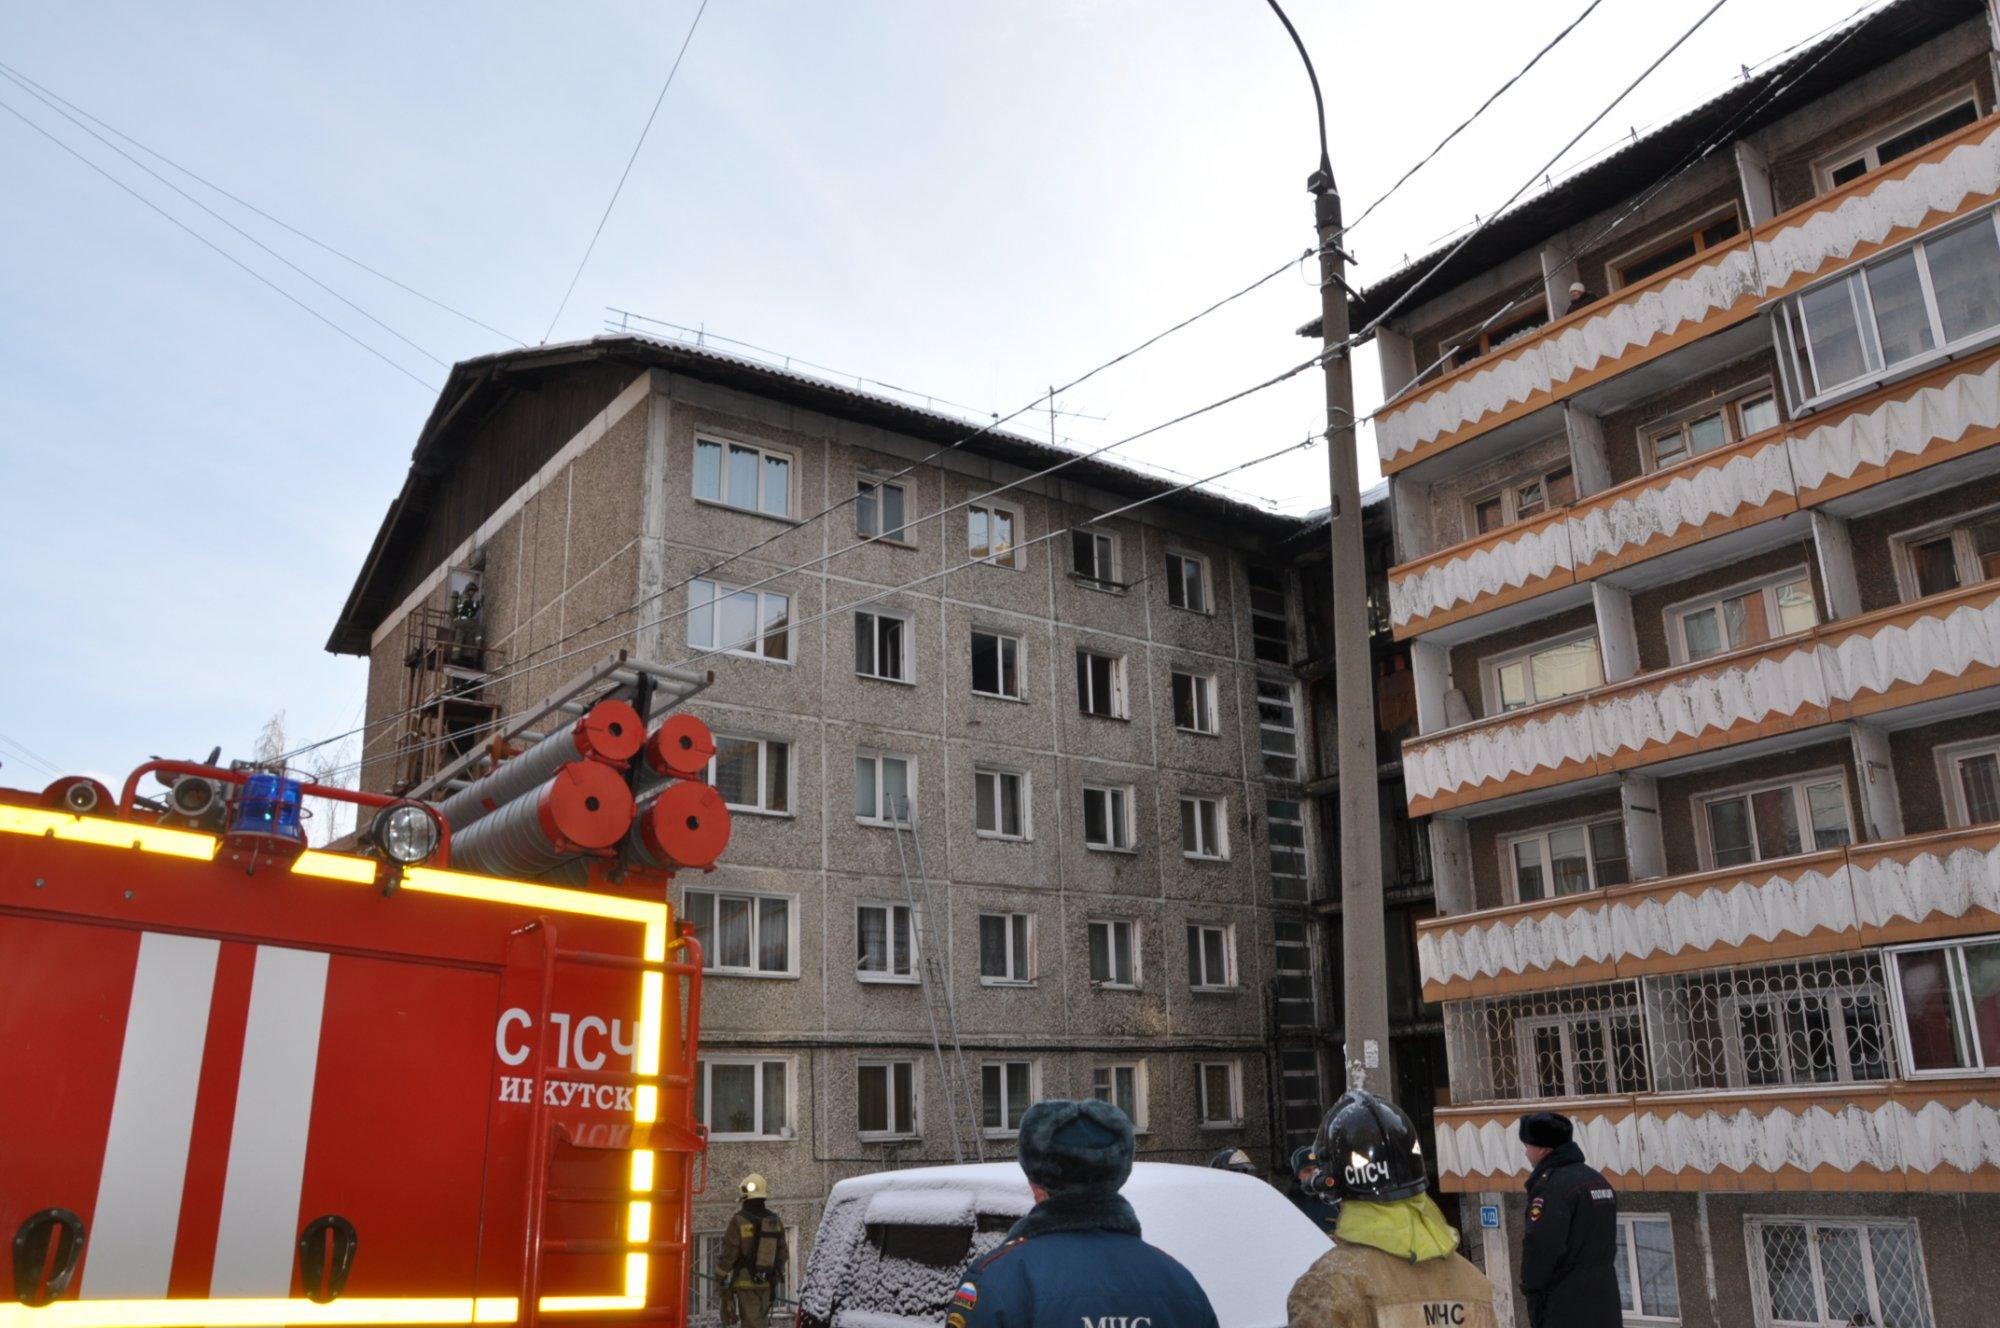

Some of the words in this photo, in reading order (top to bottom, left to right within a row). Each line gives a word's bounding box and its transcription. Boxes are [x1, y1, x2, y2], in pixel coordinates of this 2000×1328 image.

[1345, 1161, 1389, 1185] СПСЧ
[1590, 1189, 1614, 1200] ПОЛИЦИ
[1423, 1303, 1465, 1326] МЧС
